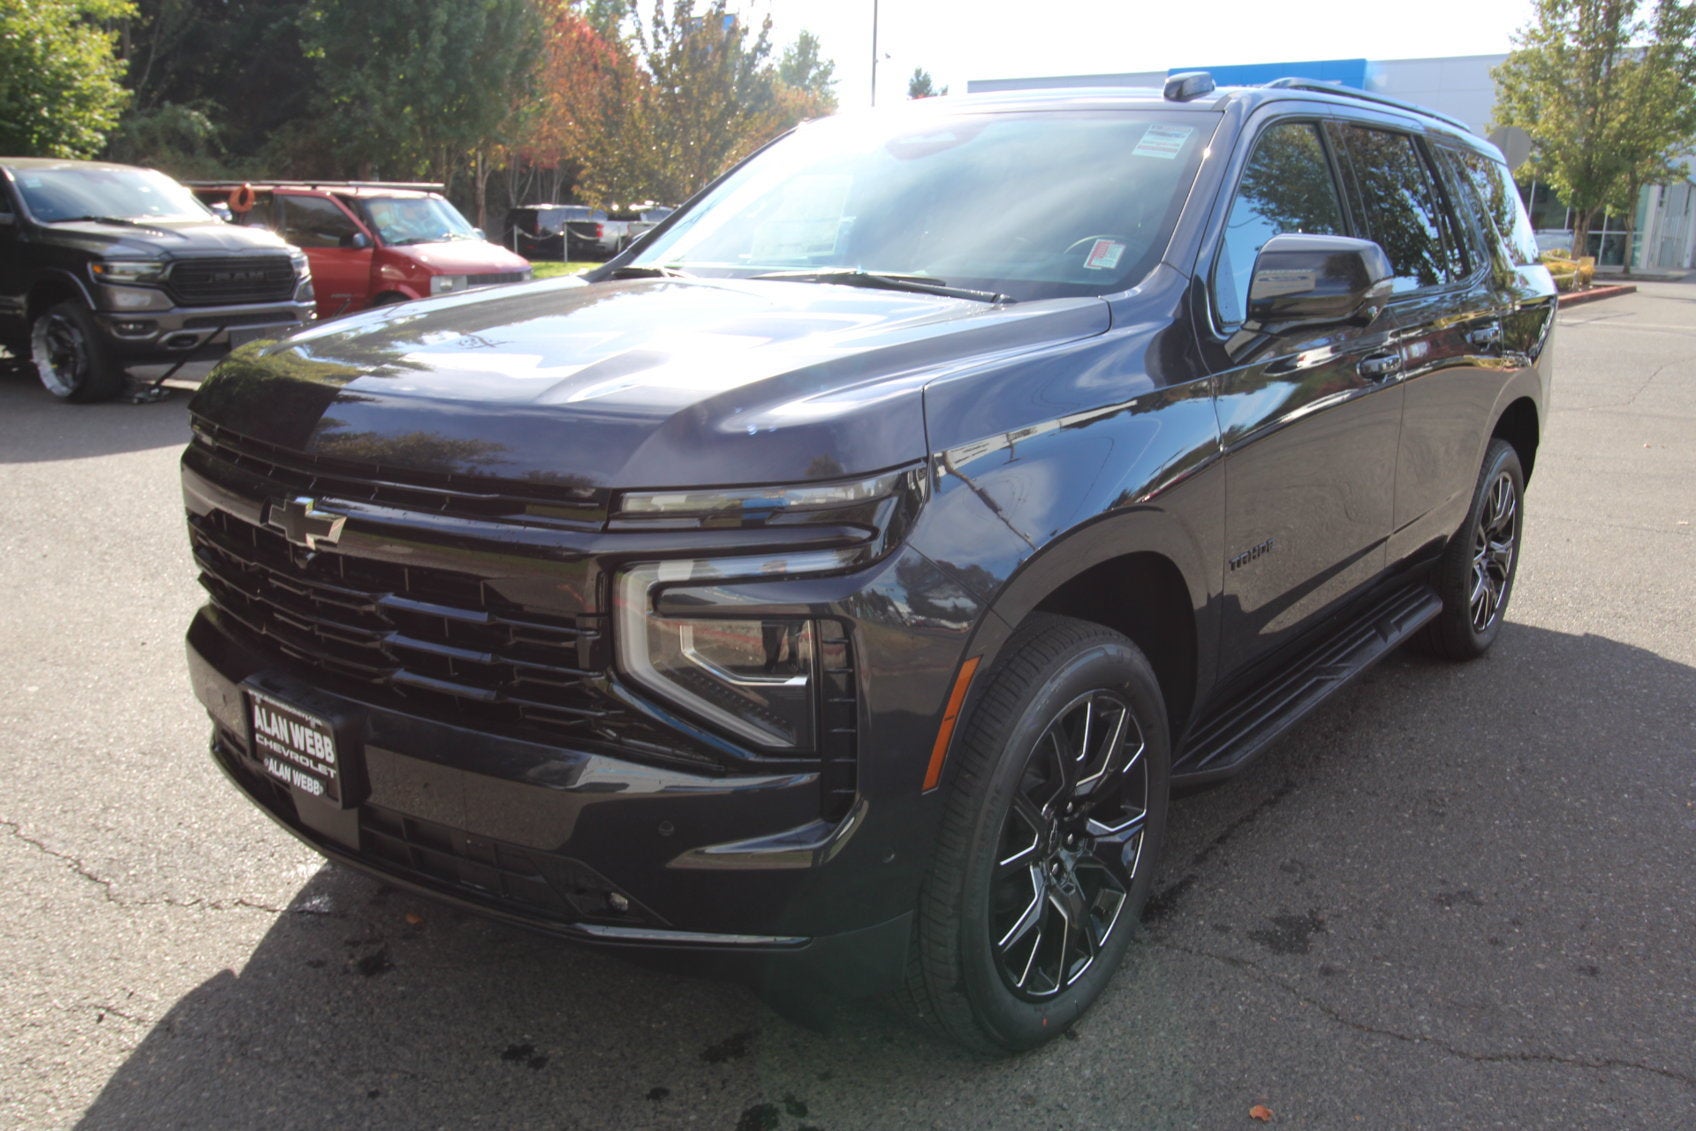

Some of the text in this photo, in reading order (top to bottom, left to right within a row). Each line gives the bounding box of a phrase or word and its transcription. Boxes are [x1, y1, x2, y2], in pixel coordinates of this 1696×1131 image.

[214, 271, 265, 282] RAM
[1228, 537, 1276, 571] TAHOE
[254, 705, 289, 744] ALAN
[290, 721, 335, 763] WEBB
[255, 733, 337, 778] CHEVROLET
[268, 758, 320, 796] ALAN WEBB
